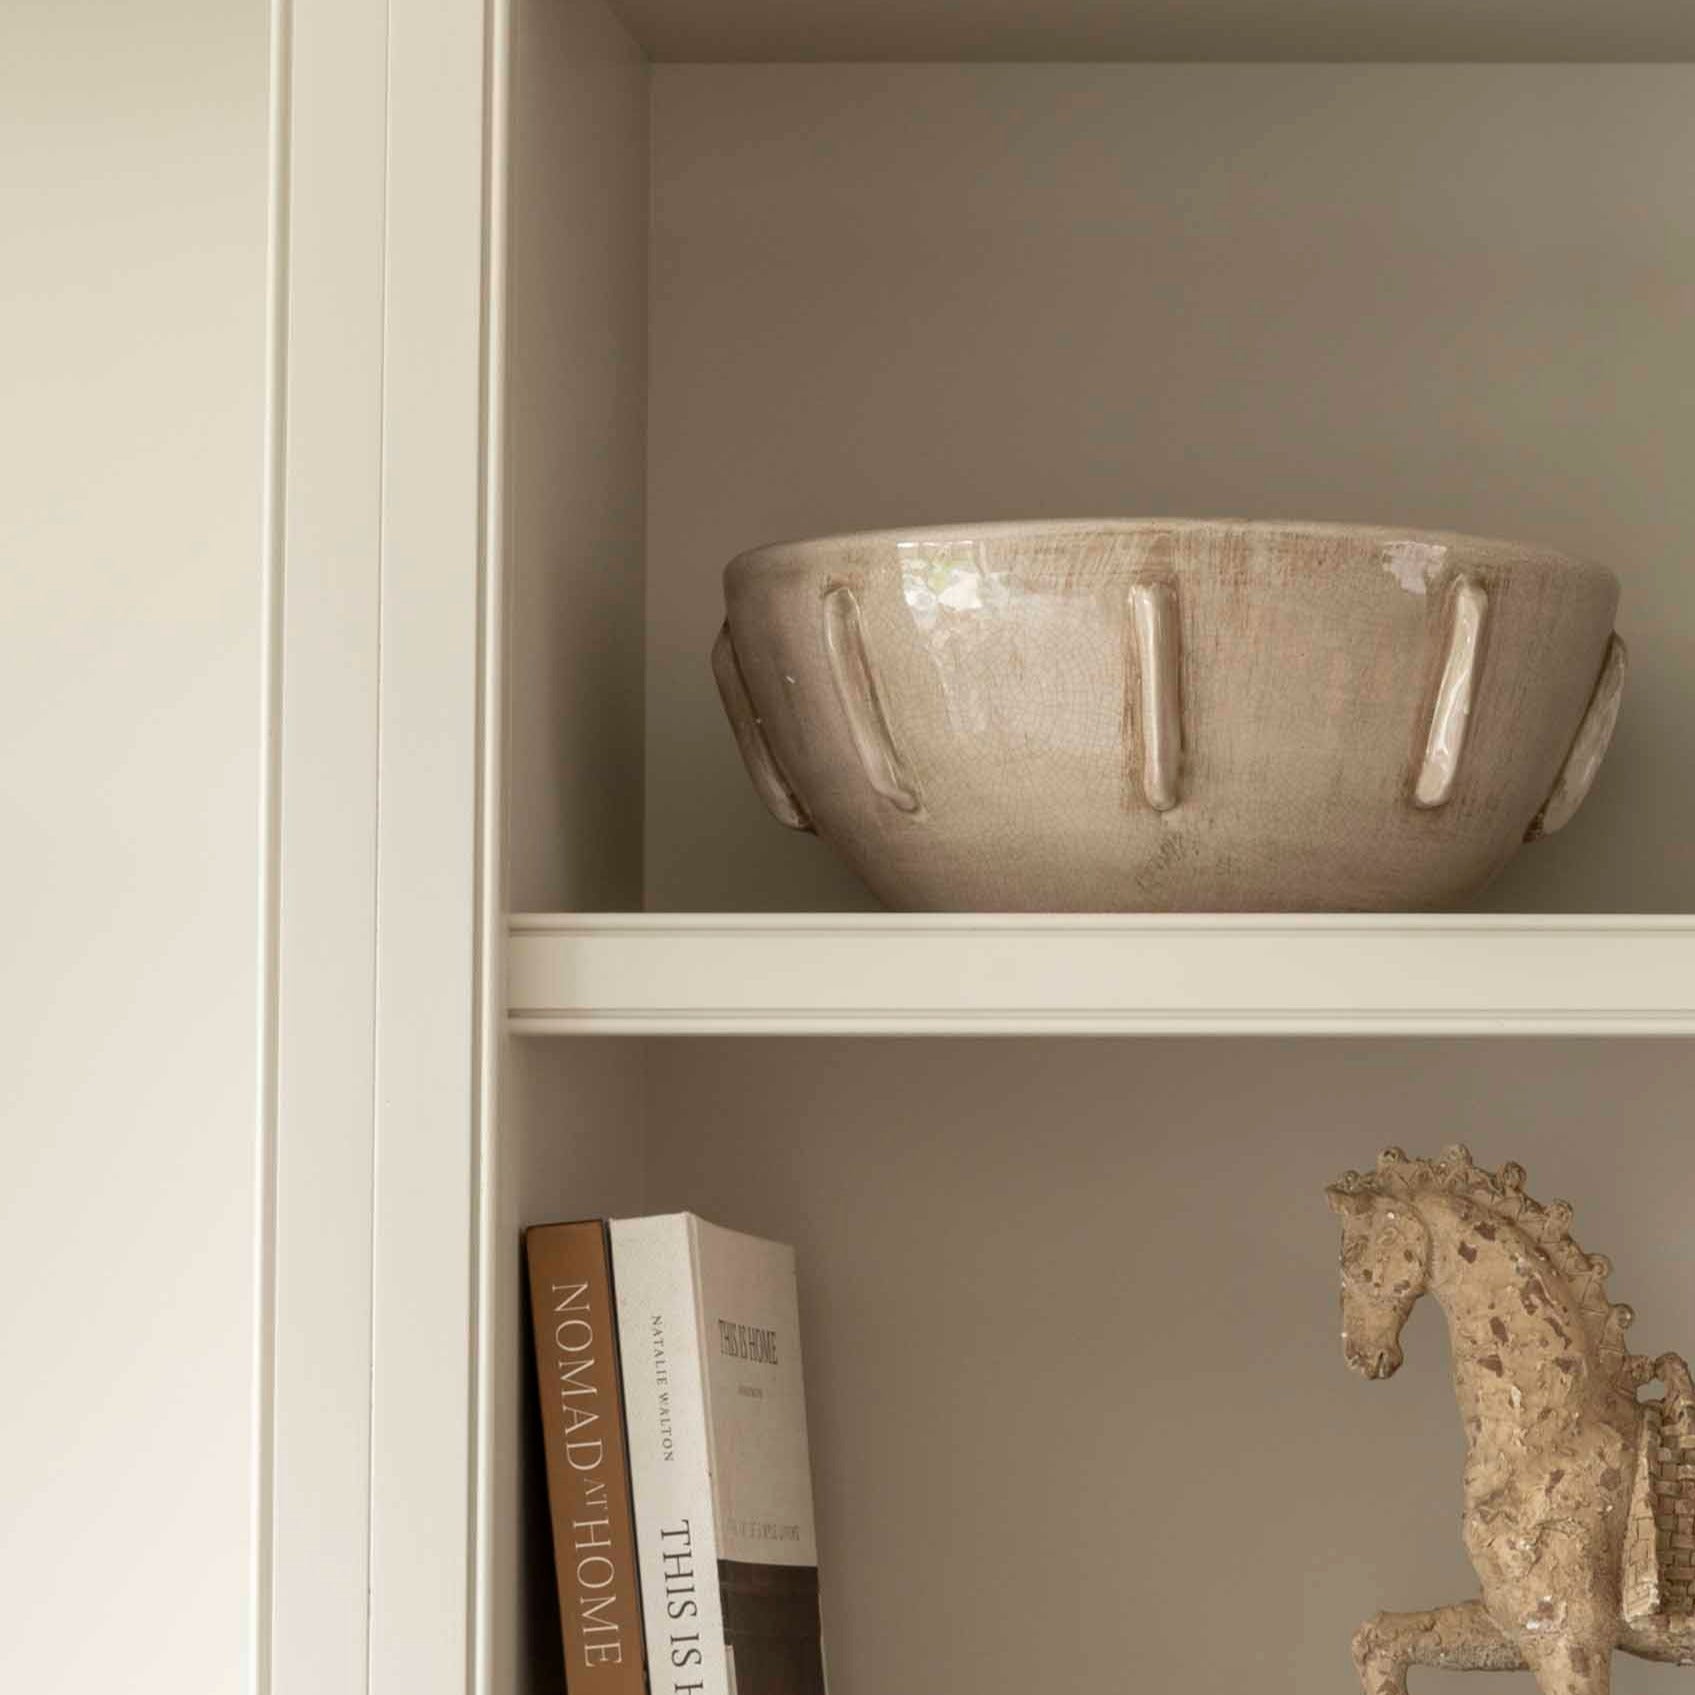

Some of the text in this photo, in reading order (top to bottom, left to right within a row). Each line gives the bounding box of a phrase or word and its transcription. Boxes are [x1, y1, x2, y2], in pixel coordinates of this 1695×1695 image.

[652, 1315, 674, 1462] NATALIE WALTON
[719, 1319, 778, 1366] THIS IS HOME
[552, 1281, 622, 1668] NOMAD AT HOME
[661, 1519, 697, 1619] THIS
[670, 1632, 702, 1667] IS
